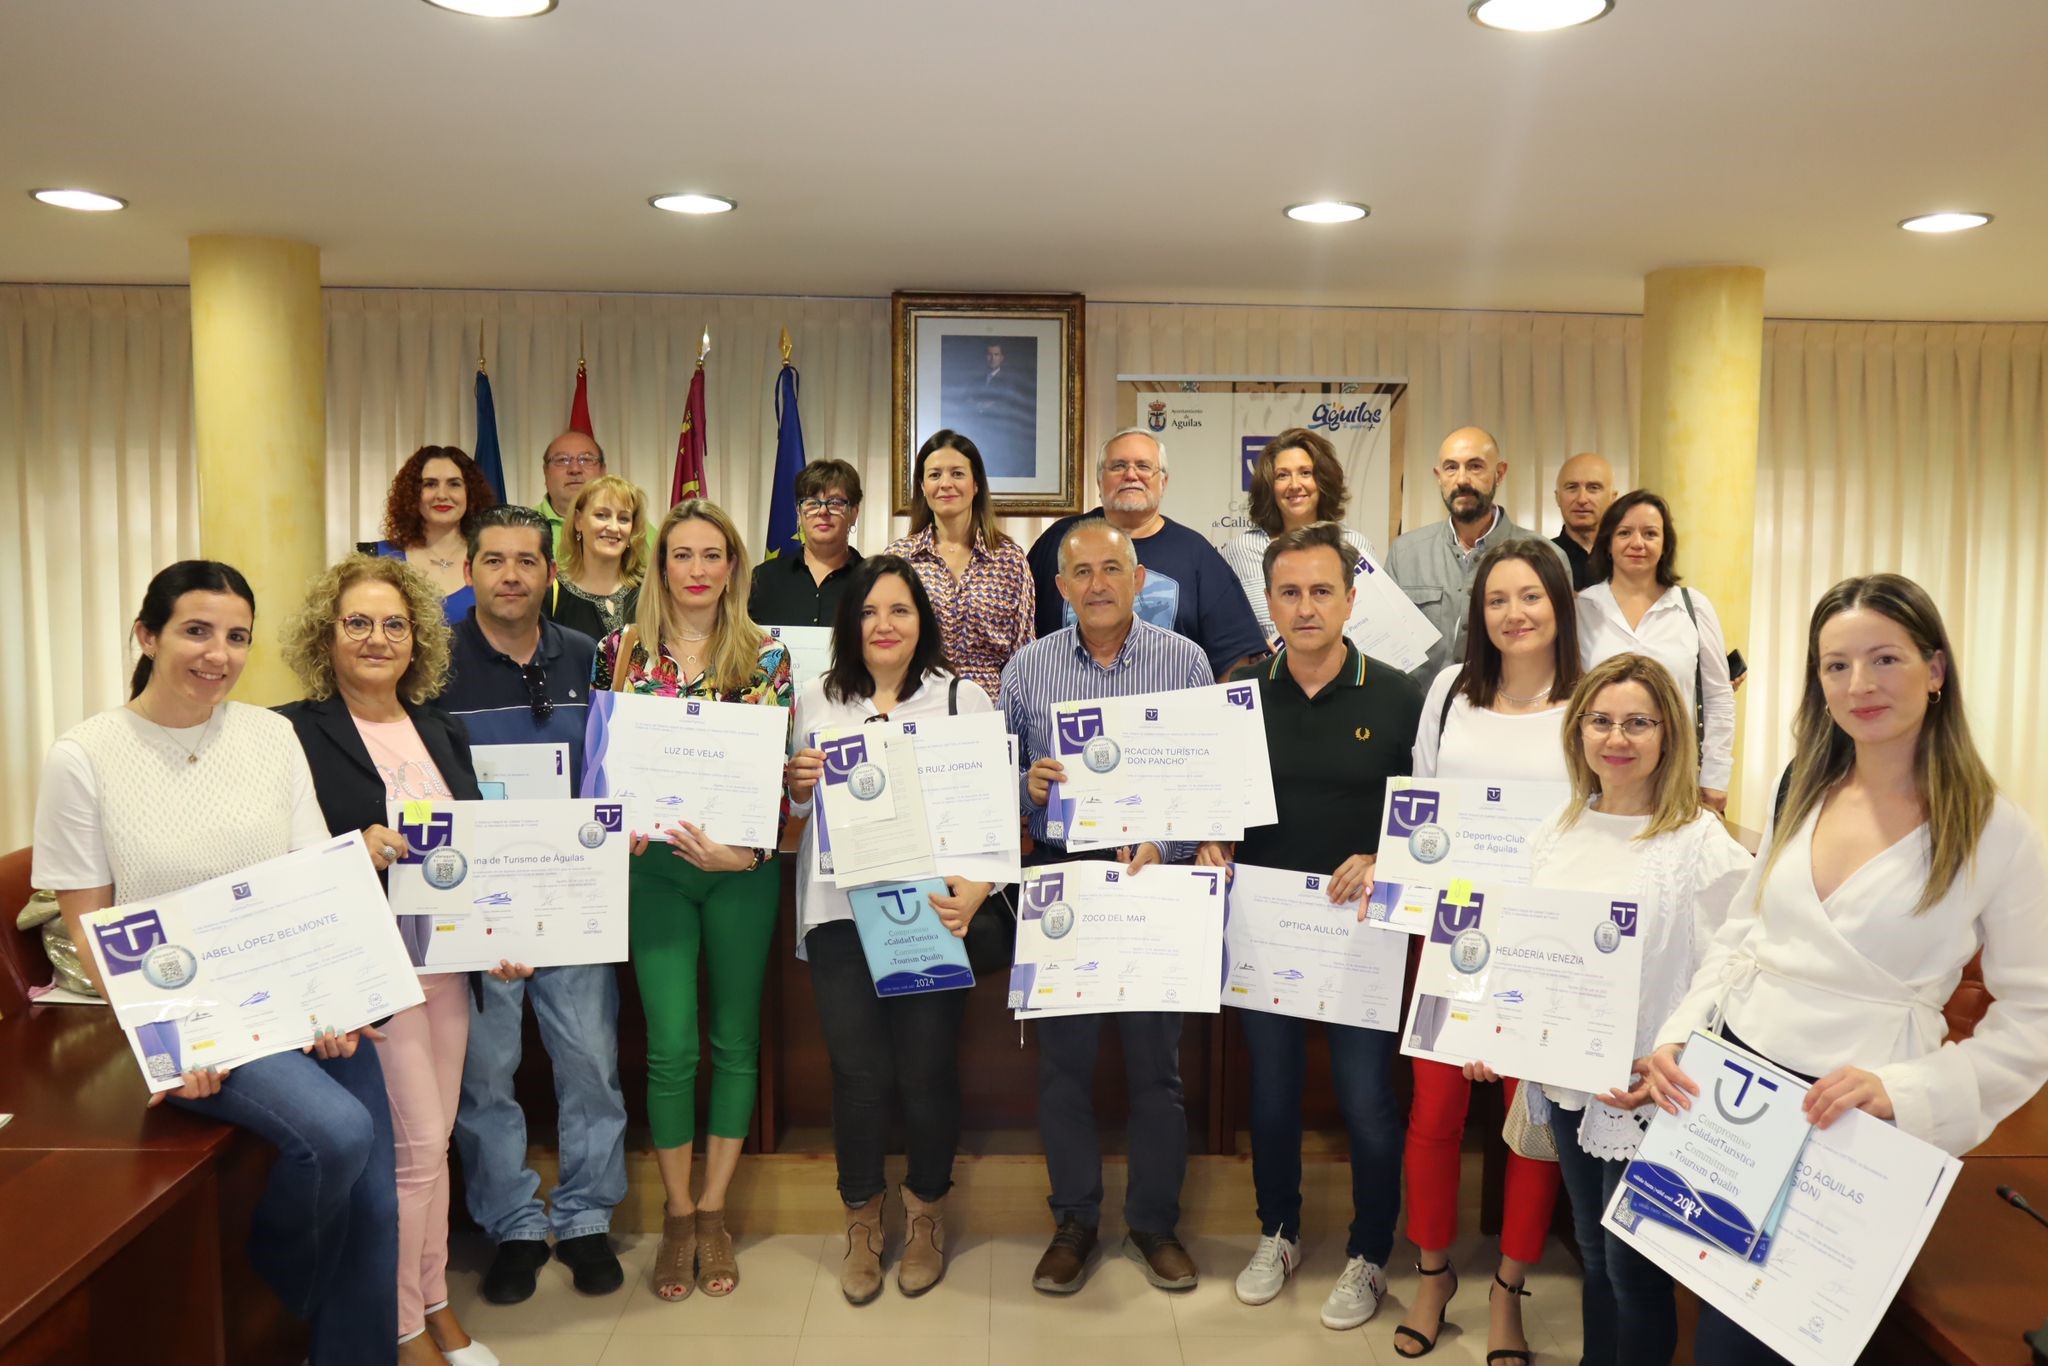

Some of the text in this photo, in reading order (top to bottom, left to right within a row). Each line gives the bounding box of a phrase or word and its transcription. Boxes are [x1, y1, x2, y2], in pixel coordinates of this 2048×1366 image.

[664, 746, 725, 759] LUZ DE VELAS
[1165, 747, 1210, 756] TURÍSTICA
[917, 761, 983, 775] S RUIZ JORDÁN
[1462, 830, 1525, 844] Deportivo-Club
[1474, 842, 1518, 854] de Águilas
[489, 855, 500, 865] de
[503, 854, 539, 865] Turismo
[540, 854, 551, 864] de
[553, 852, 585, 865] Águilas
[1081, 914, 1146, 923] ZOCO DEL MAR
[237, 931, 276, 951] LÓPEZ
[277, 913, 339, 941] BELMONTE
[892, 956, 920, 965] Tourism
[920, 953, 944, 963] Quality
[1495, 945, 1584, 966] HELADERÍA VENEZIA
[914, 977, 935, 989] 2024
[1698, 1113, 1752, 1150] Compromiso
[1684, 1141, 1739, 1179] Commitment
[1674, 1149, 1742, 1197] Tourism Quality
[1813, 1169, 1865, 1205] ÁGUILAS
[1673, 1193, 1704, 1219] 2024
